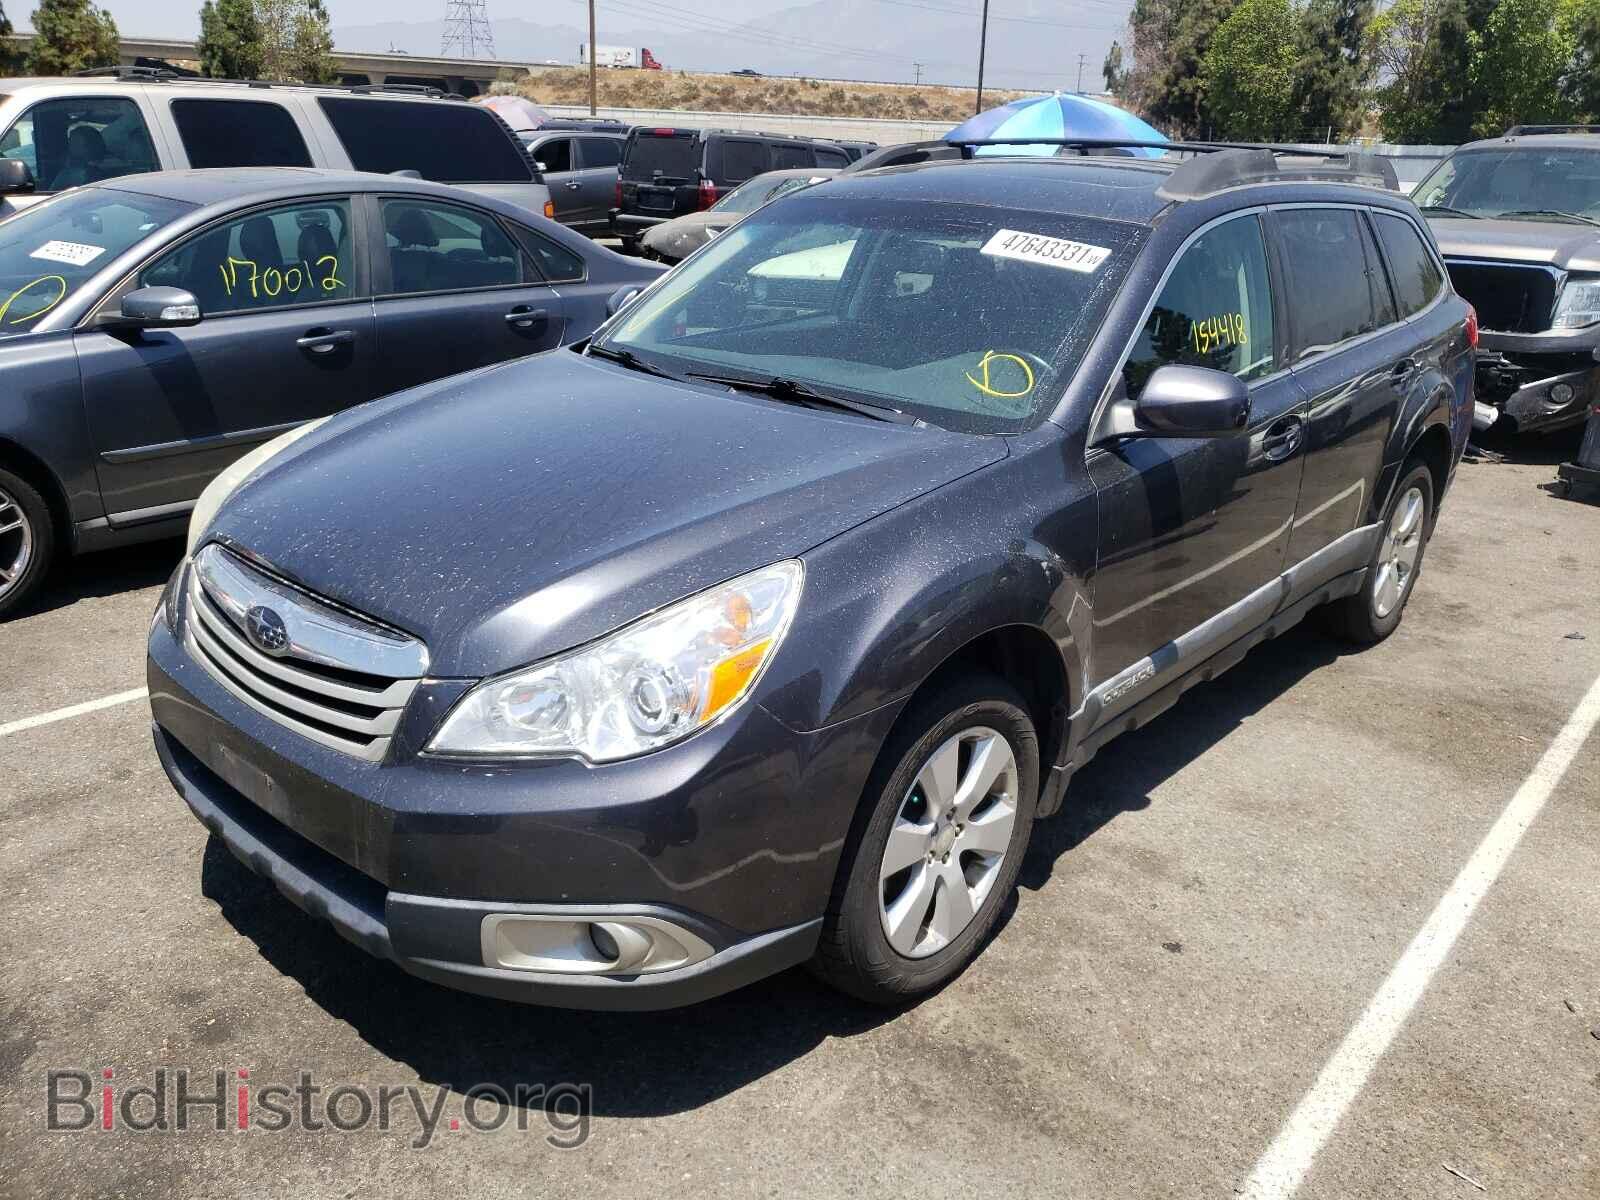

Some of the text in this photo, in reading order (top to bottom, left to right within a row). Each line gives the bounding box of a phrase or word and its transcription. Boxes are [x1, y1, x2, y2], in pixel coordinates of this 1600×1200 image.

[220, 256, 347, 298] 170012
[1187, 312, 1248, 354] 154418
[964, 349, 1034, 397] D
